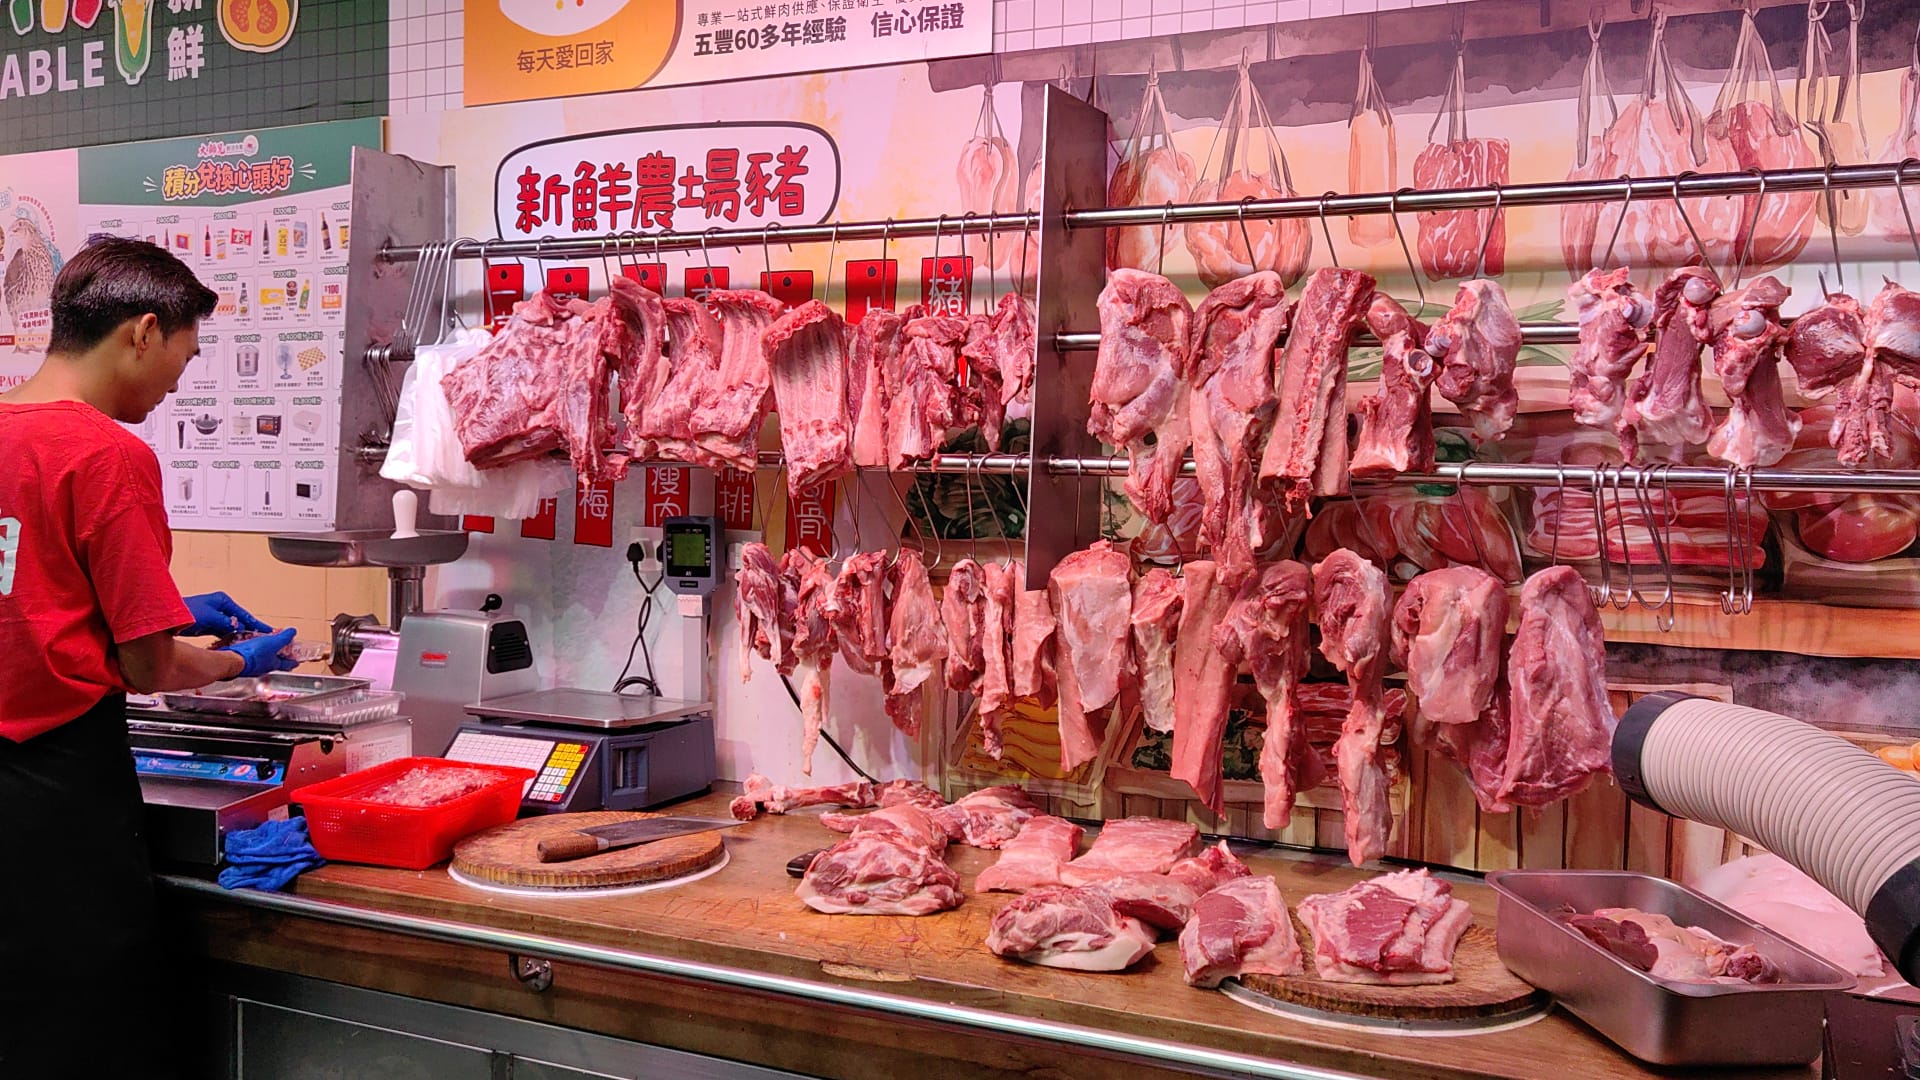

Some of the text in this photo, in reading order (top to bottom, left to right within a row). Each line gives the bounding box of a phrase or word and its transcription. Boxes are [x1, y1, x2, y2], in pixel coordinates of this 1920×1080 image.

[517, 40, 614, 73] 每天愛回家
[693, 5, 965, 56] 五豐60多年經驗 信心保證
[0, 40, 105, 100] ABLE
[516, 145, 809, 233] 新鮮農場豬
